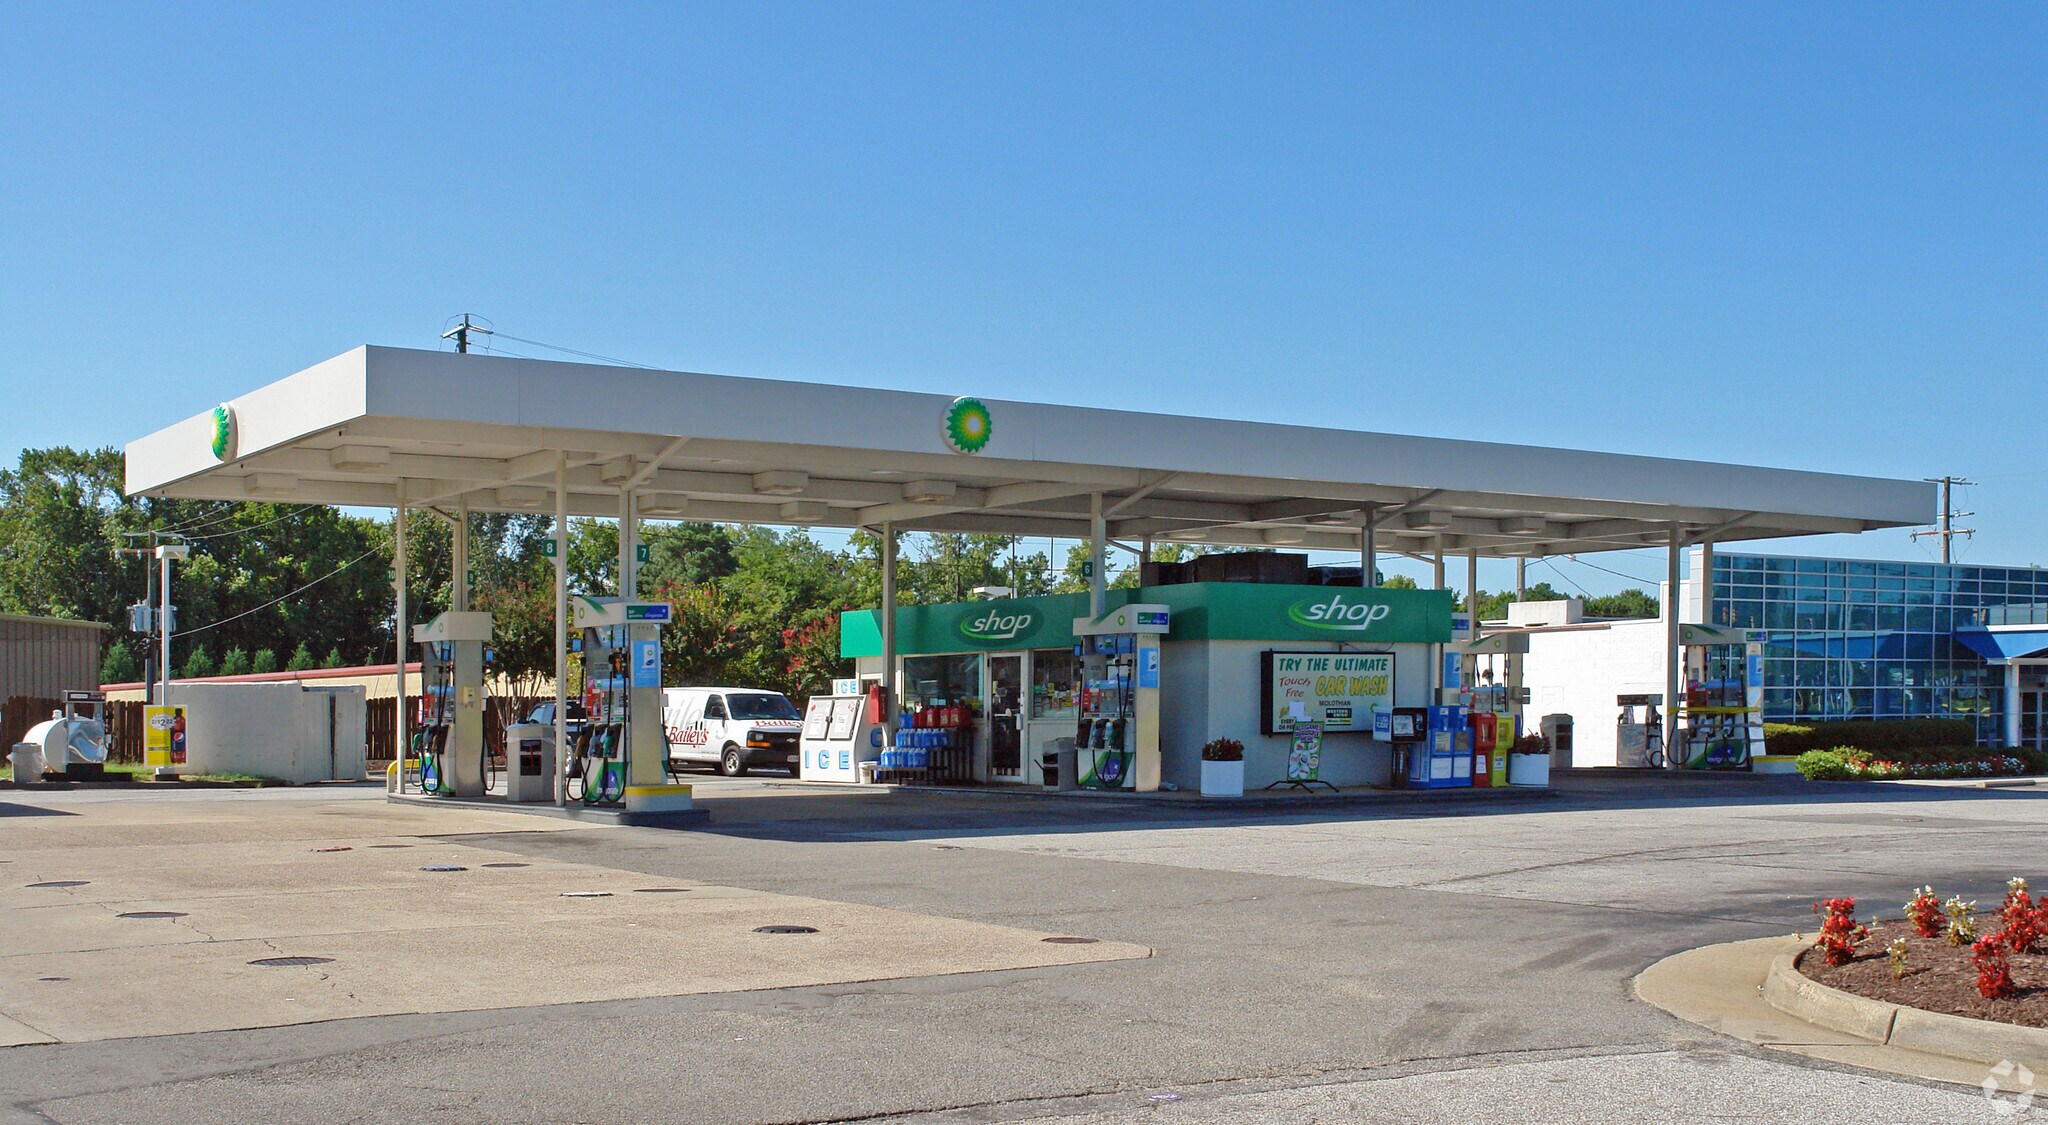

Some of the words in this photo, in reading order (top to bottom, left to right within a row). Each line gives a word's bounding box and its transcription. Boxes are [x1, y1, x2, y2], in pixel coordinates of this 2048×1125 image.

[546, 542, 553, 554] 8
[641, 547, 648, 559] 7
[387, 570, 396, 579] 10
[1301, 594, 1390, 631] shop
[966, 609, 1031, 639] shop
[1279, 658, 1303, 671] TRY
[1307, 658, 1330, 671] THE
[1334, 658, 1389, 671] ULTIMATE
[835, 681, 857, 694] ICE
[1279, 676, 1312, 687] Touch
[1315, 675, 1347, 697] CAR
[1350, 675, 1389, 697] WASH
[1285, 687, 1304, 698] Free
[668, 726, 709, 748] Bailey's
[804, 750, 850, 769] ICE
